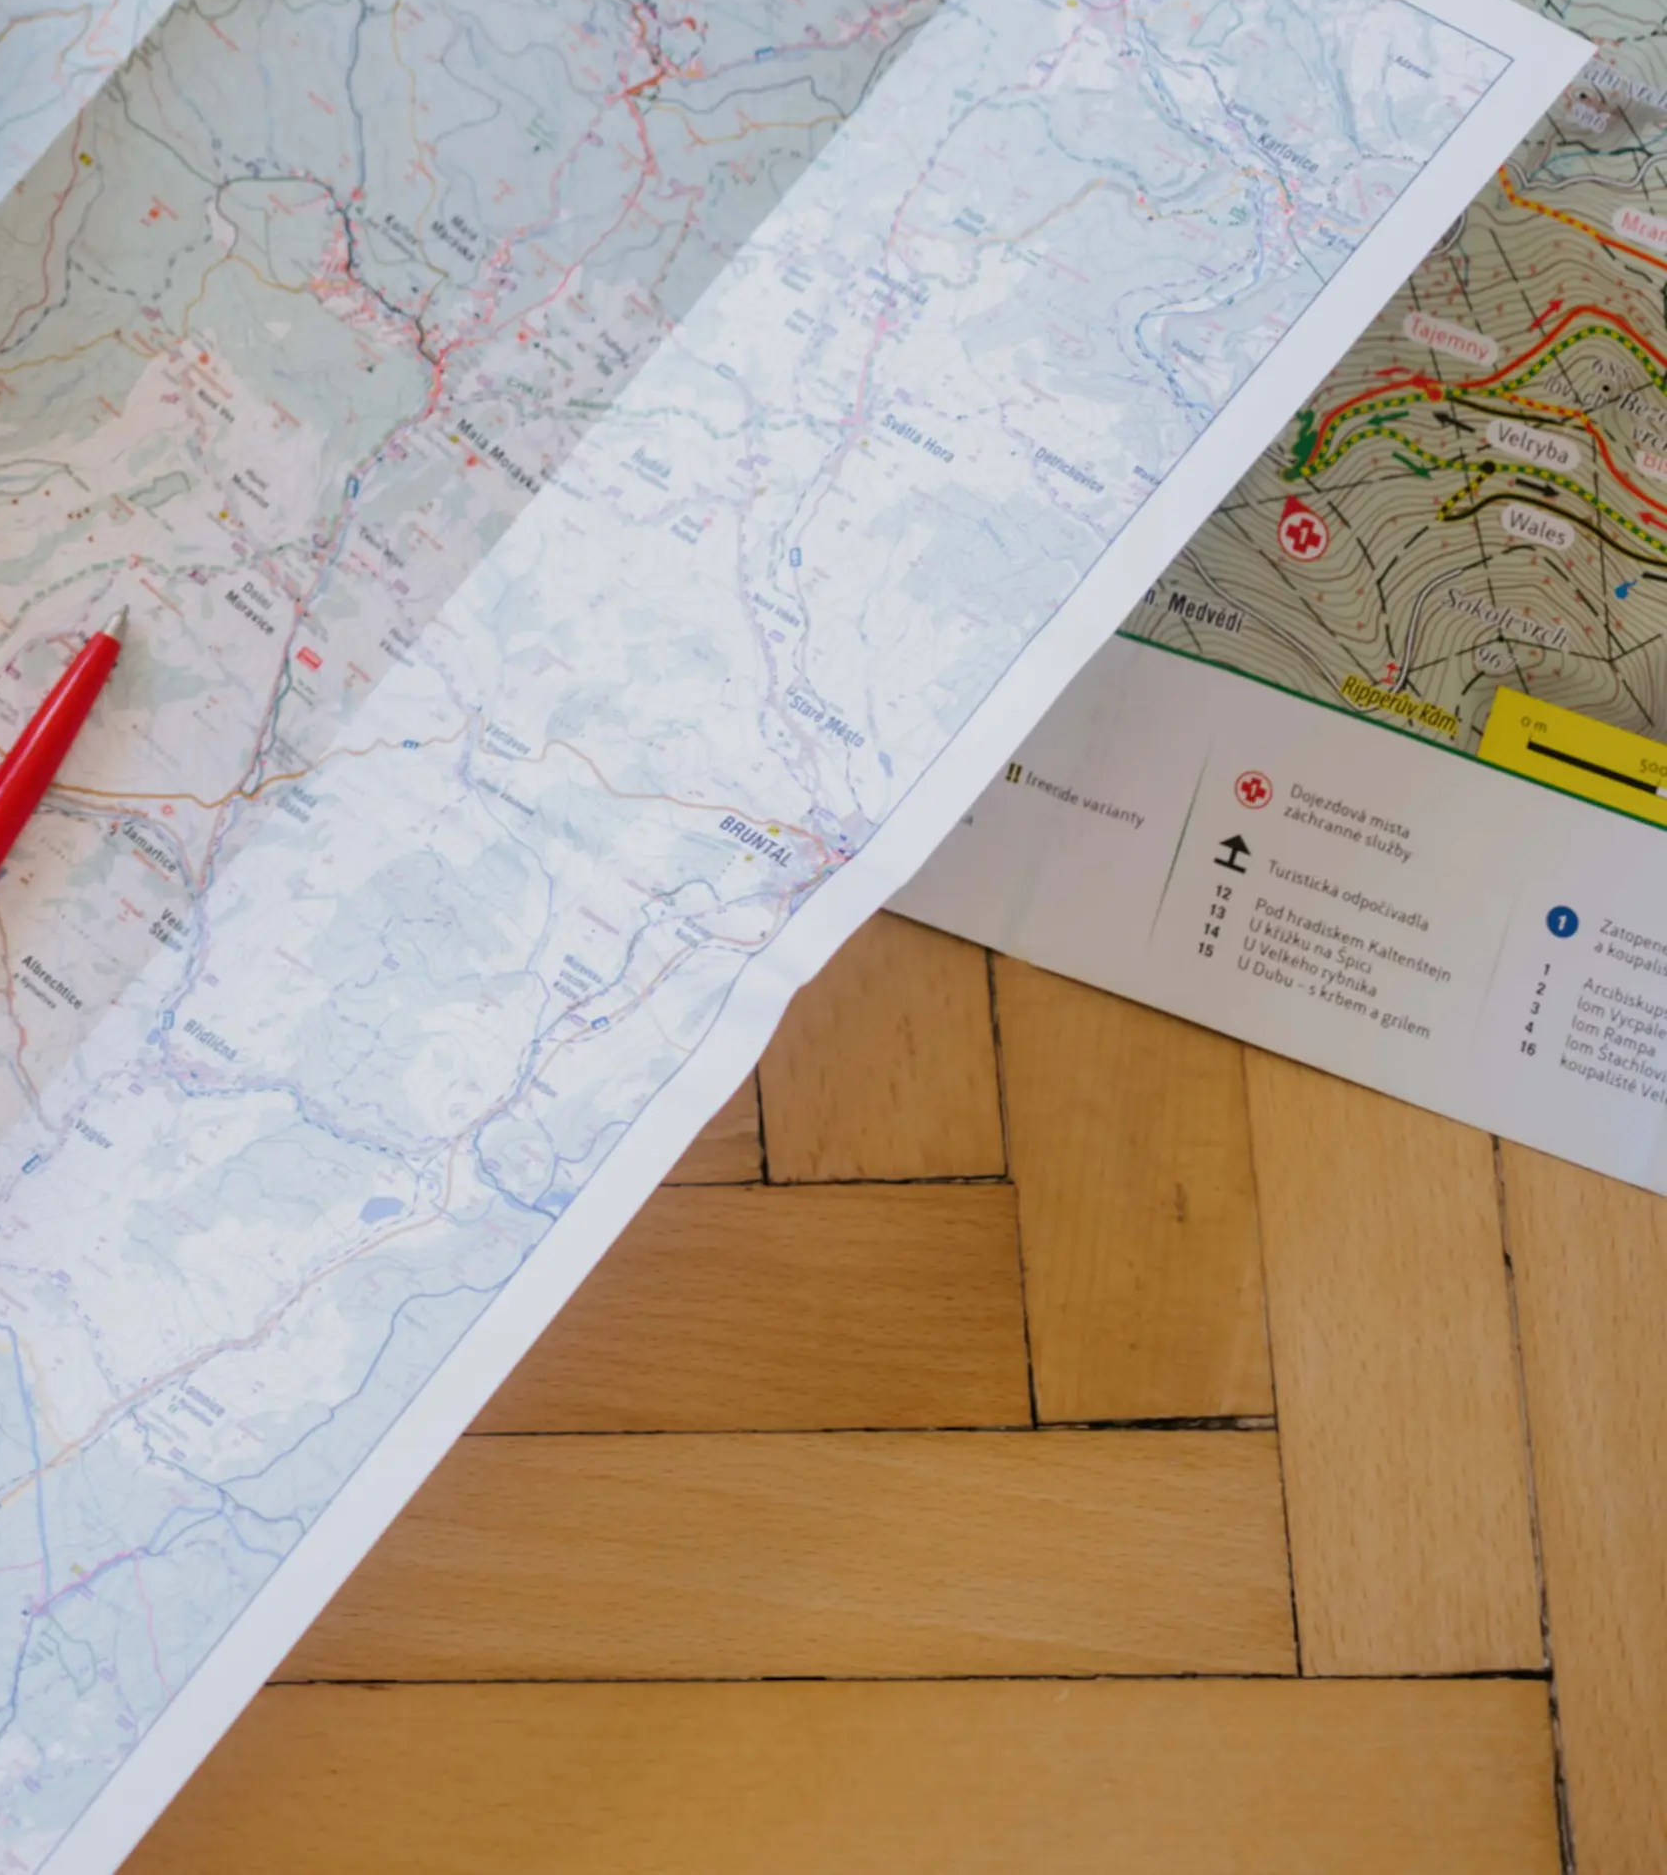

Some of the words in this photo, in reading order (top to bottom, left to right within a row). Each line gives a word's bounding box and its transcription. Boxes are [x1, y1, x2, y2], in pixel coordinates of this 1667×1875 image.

[1492, 422, 1573, 471] Velryba
[1505, 509, 1570, 548] Wales
[1079, 793, 1147, 832] varianty
[1286, 781, 1369, 827] Dojezdová
[716, 810, 795, 871] BRUNTÁL
[1362, 831, 1414, 865] služby
[1265, 858, 1342, 899] Turistická
[1207, 901, 1228, 922] 13
[1247, 917, 1262, 934] U
[1311, 941, 1334, 962] na
[1213, 882, 1233, 902] 12
[1252, 896, 1284, 921] Pod
[1283, 907, 1367, 952] hradiskem
[1202, 920, 1222, 940] 14
[1241, 936, 1257, 954] U
[1257, 941, 1321, 978] Velkého
[1195, 939, 1216, 960] 15
[1235, 954, 1250, 973] U
[1250, 960, 1297, 990] Dubu
[1315, 984, 1370, 1019] krbem
[1377, 1009, 1433, 1046] grilem
[1534, 980, 1548, 998] 2
[1574, 994, 1608, 1019] lom
[1517, 1038, 1538, 1059] 16
[1522, 1018, 1536, 1036] 4
[1562, 1032, 1597, 1058] lom
[1528, 999, 1543, 1018] 3
[1569, 1013, 1602, 1038] lom
[1599, 1025, 1659, 1062] Rampa
